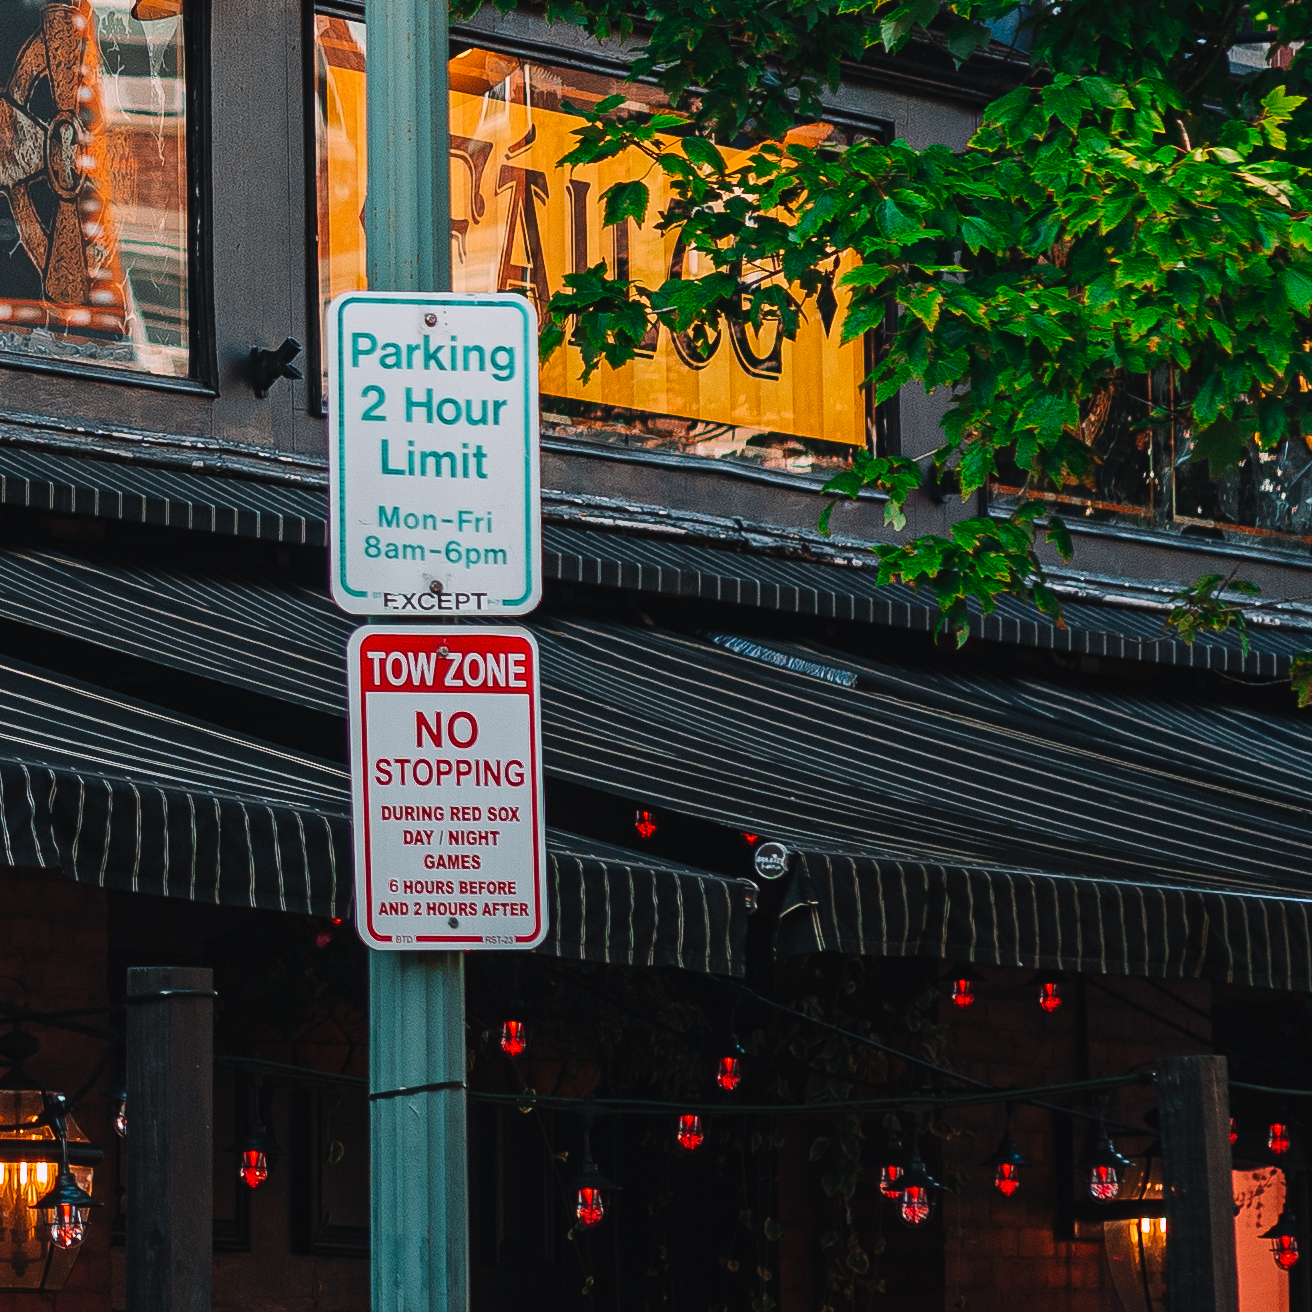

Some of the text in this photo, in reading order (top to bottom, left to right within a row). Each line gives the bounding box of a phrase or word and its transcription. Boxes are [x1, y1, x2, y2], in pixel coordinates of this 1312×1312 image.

[351, 332, 515, 381] Parking
[361, 385, 508, 426] 2 Hour
[381, 439, 488, 479] Limit
[378, 505, 492, 533] Mon-Fri
[364, 535, 508, 569] 8am-6pm
[383, 592, 487, 610] EXCEPT
[367, 651, 527, 687] TOW ZONE
[416, 711, 479, 748] NO
[375, 758, 525, 787] STOPPING
[381, 805, 520, 822] DURING RED SOX
[403, 830, 434, 845] DAY
[448, 830, 500, 845] NIGHT
[424, 854, 481, 869] GAMES
[389, 879, 517, 895] 6 HOURS BEFORE
[378, 902, 529, 917] AND 2 HOURS AFTER
